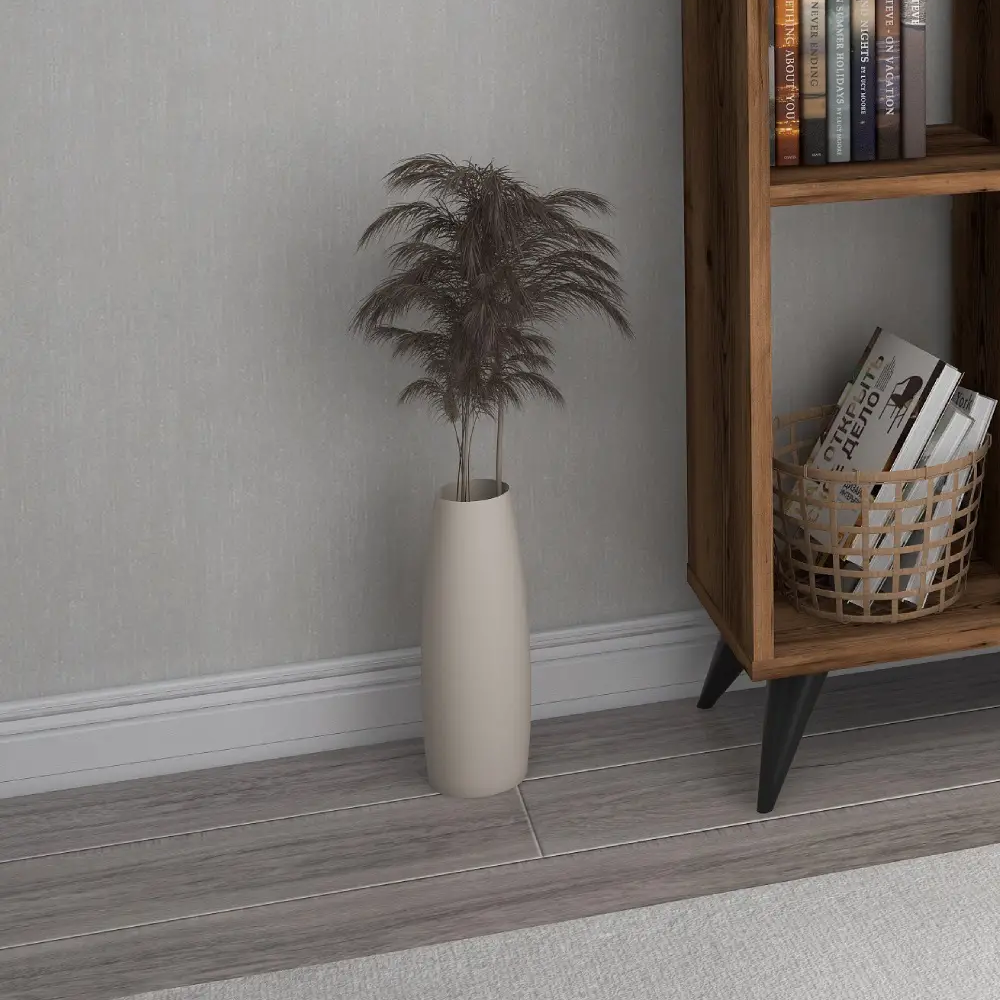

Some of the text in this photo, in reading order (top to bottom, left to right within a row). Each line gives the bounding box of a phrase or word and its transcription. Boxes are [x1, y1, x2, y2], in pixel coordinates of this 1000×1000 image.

[810, 1, 819, 87] NEVER ENDING
[835, 6, 844, 50] SUMMER
[860, 20, 869, 63] NIGHTS
[885, 36, 894, 53] ON
[784, 49, 795, 89] ABOUT
[835, 53, 845, 104] HOLIDAYS
[860, 66, 866, 74] BY
[885, 57, 895, 116] VACATION
[784, 94, 795, 120] YOU
[836, 107, 842, 116] BY
[823, 356, 885, 462] ОТКРЫТЬ
[842, 391, 881, 460] ДЕЛО
